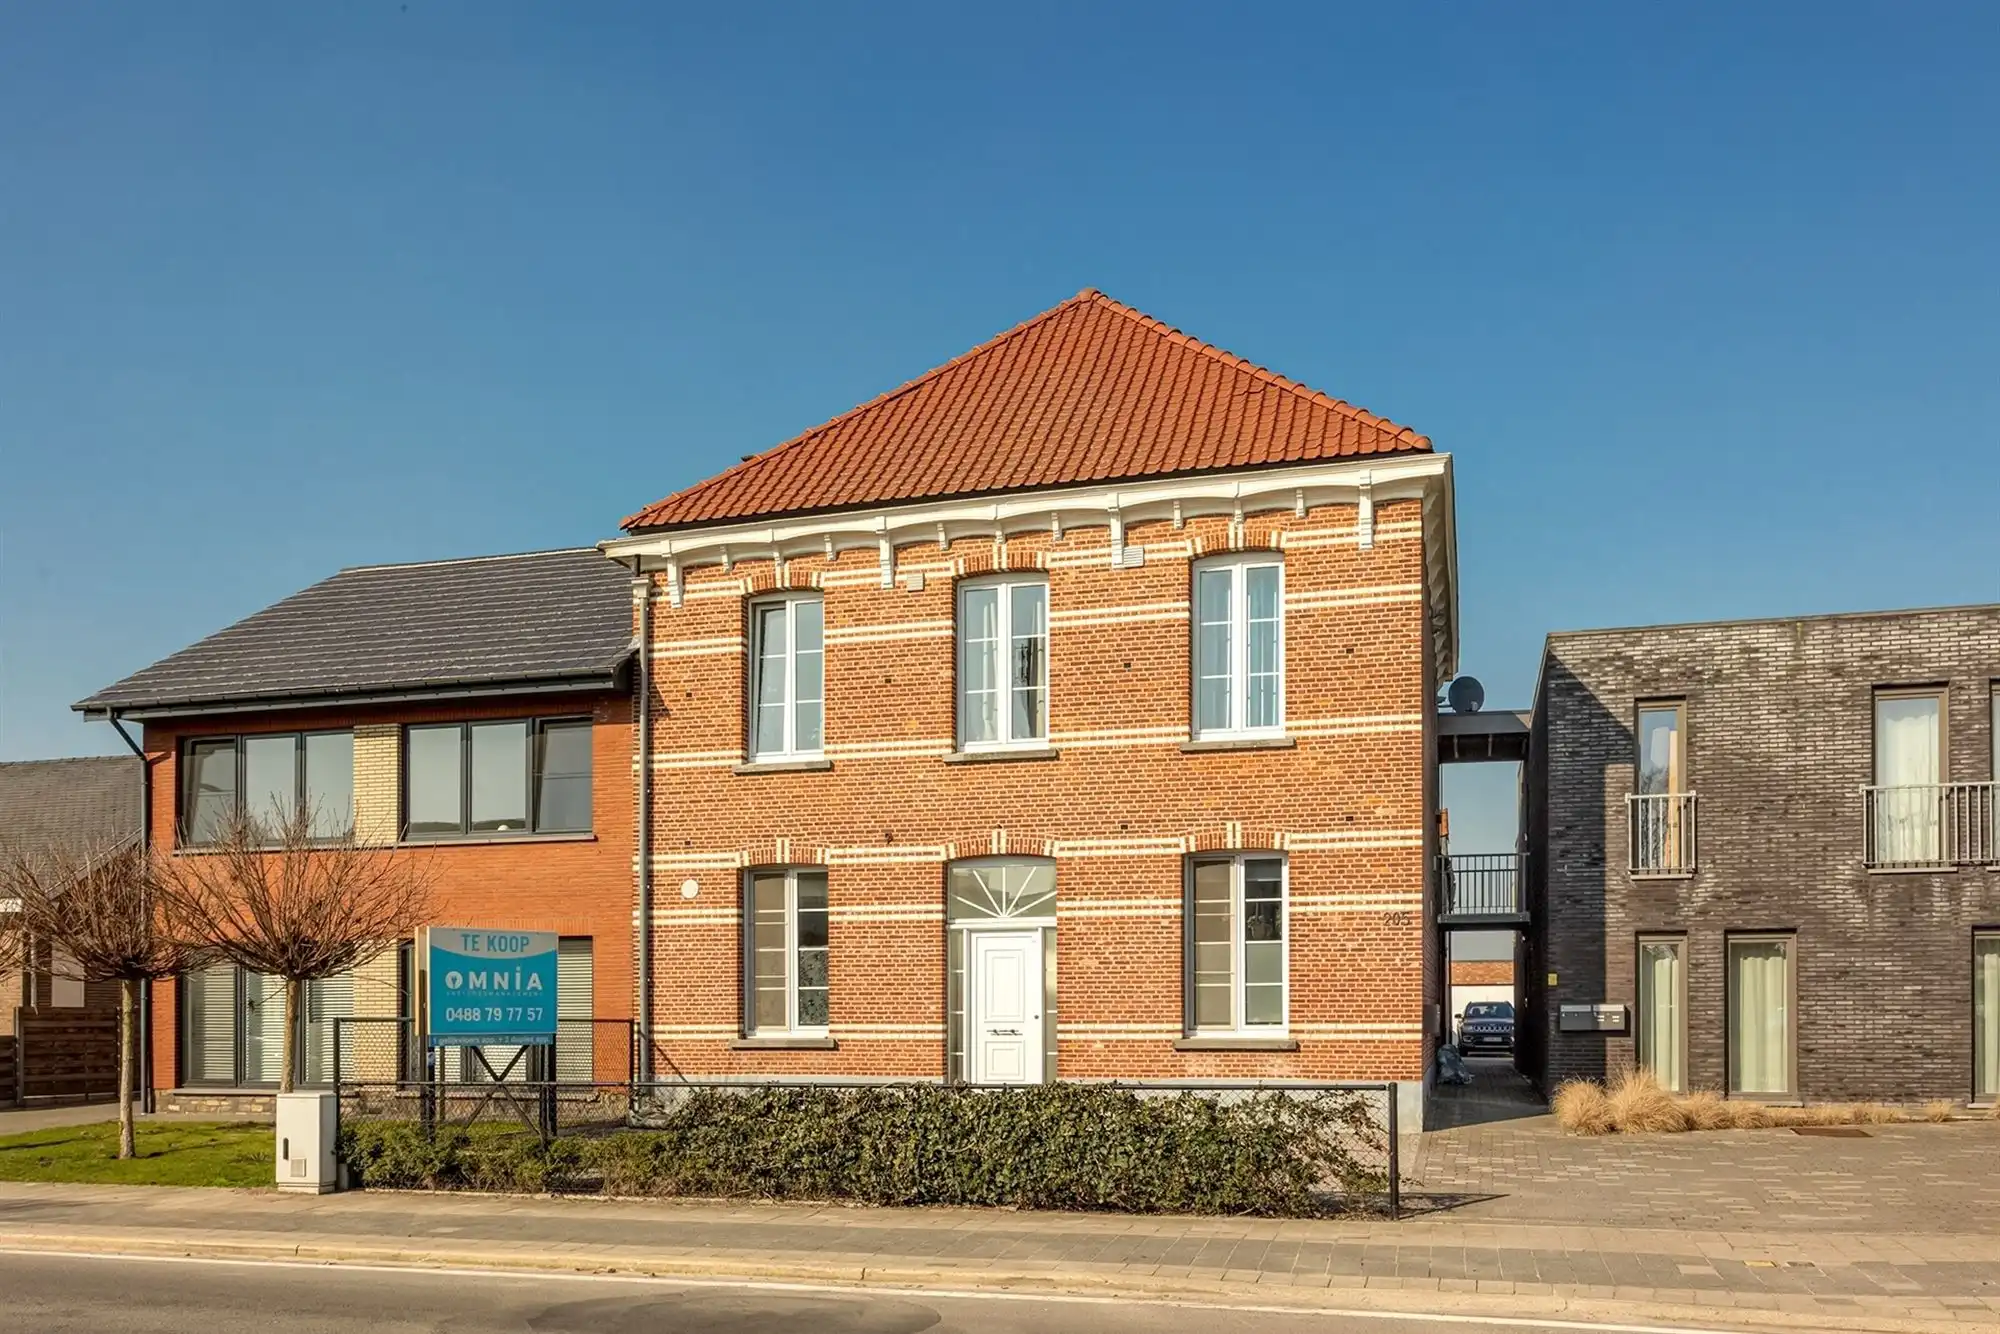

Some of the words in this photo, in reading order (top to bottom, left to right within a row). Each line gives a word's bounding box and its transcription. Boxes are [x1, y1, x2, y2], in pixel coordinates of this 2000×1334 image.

[1383, 911, 1412, 926] 205
[461, 934, 480, 951] TE
[487, 935, 529, 952] KOOP
[446, 1007, 480, 1022] 0488
[485, 1007, 502, 1022] 79
[506, 1007, 522, 1022] 77
[527, 1007, 543, 1022] 57
